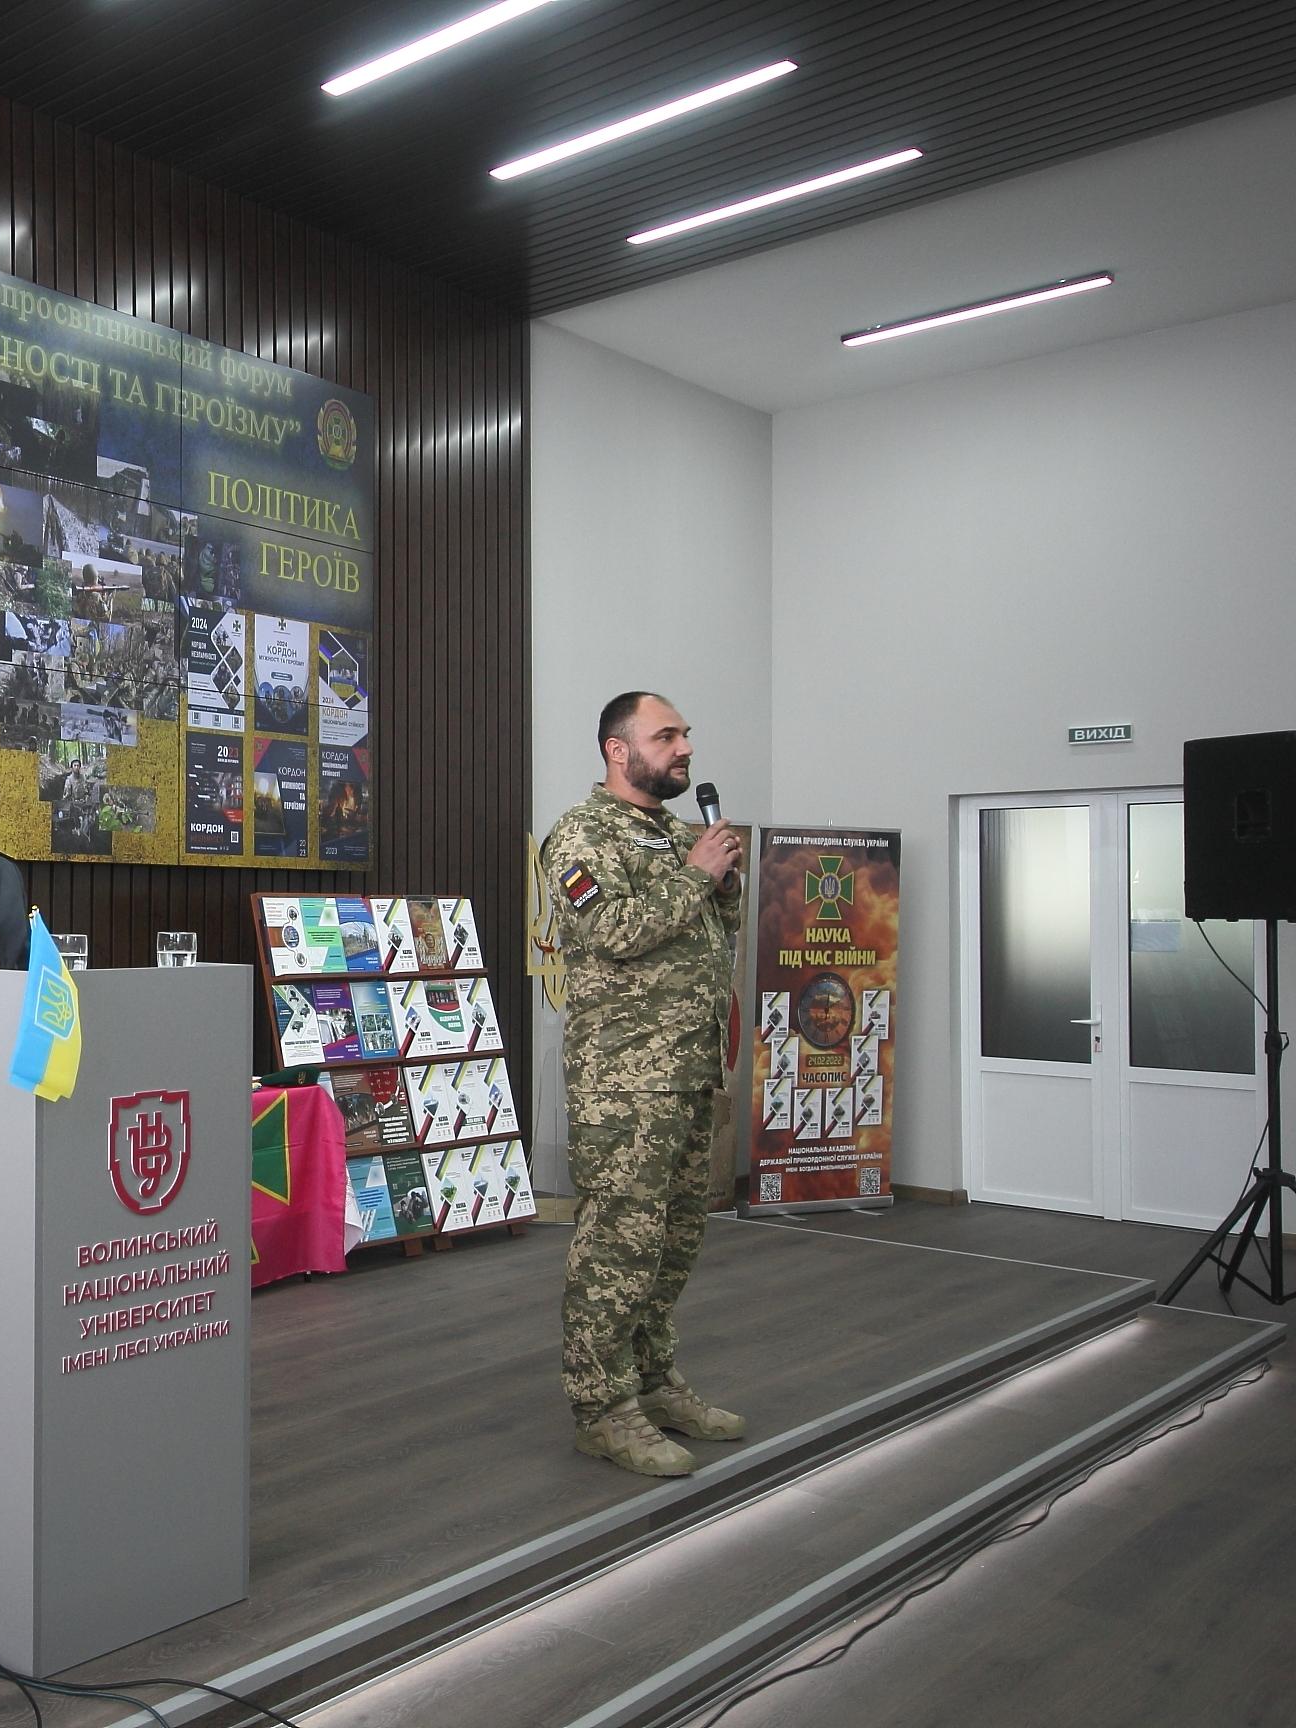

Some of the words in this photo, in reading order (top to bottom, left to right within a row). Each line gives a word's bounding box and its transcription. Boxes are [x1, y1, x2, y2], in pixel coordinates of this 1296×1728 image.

[220, 349, 293, 398] форум
[109, 368, 147, 407] ТА
[155, 381, 301, 445] ГЕРОЇЗМУ”
[208, 471, 361, 540] ПОЛІТИКА
[260, 542, 360, 593] ГЕРОЇВ
[192, 617, 208, 630] 2024
[267, 645, 296, 658] КОРДОН
[322, 708, 348, 719] КОРДОН
[1074, 727, 1125, 741] ВИХІД
[217, 745, 239, 758] 2023
[322, 751, 349, 761] КОРДОН
[278, 766, 305, 777] КОРДОН
[190, 823, 223, 834] КОРДОН
[772, 836, 802, 845] ДЕРЖАВНА
[803, 837, 842, 846] ПРИКОРДОННА
[843, 838, 865, 847] СЛУЖБА
[866, 838, 889, 848] УКРАЇНИ
[325, 847, 338, 855] 2023
[805, 928, 851, 943] НАУКА
[779, 951, 803, 968] ПІД
[805, 950, 833, 965] ЧАС
[834, 946, 876, 965] ВІЙНИ
[808, 1056, 842, 1066] 24.02.2022
[802, 1072, 847, 1083] ЧАСОПИС
[828, 1144, 856, 1152] АКАДЕМІЯ
[760, 1157, 793, 1167] ДЕРЖАВНОЇ
[793, 1155, 836, 1164] ПРИКОРДОННОЇ
[837, 1154, 860, 1162] СЛУЖБИ
[77, 1218, 218, 1267] ВОЛИНСЬКИЙ
[63, 1250, 230, 1306] НАЦІОНАЛЬНИЙ
[79, 1290, 216, 1339] УНІВЕРСИТЕТ
[61, 1347, 109, 1374] ІМЕНІ
[112, 1338, 150, 1362] ЛЕСІ
[154, 1319, 230, 1352] УКРАЇНКИ
